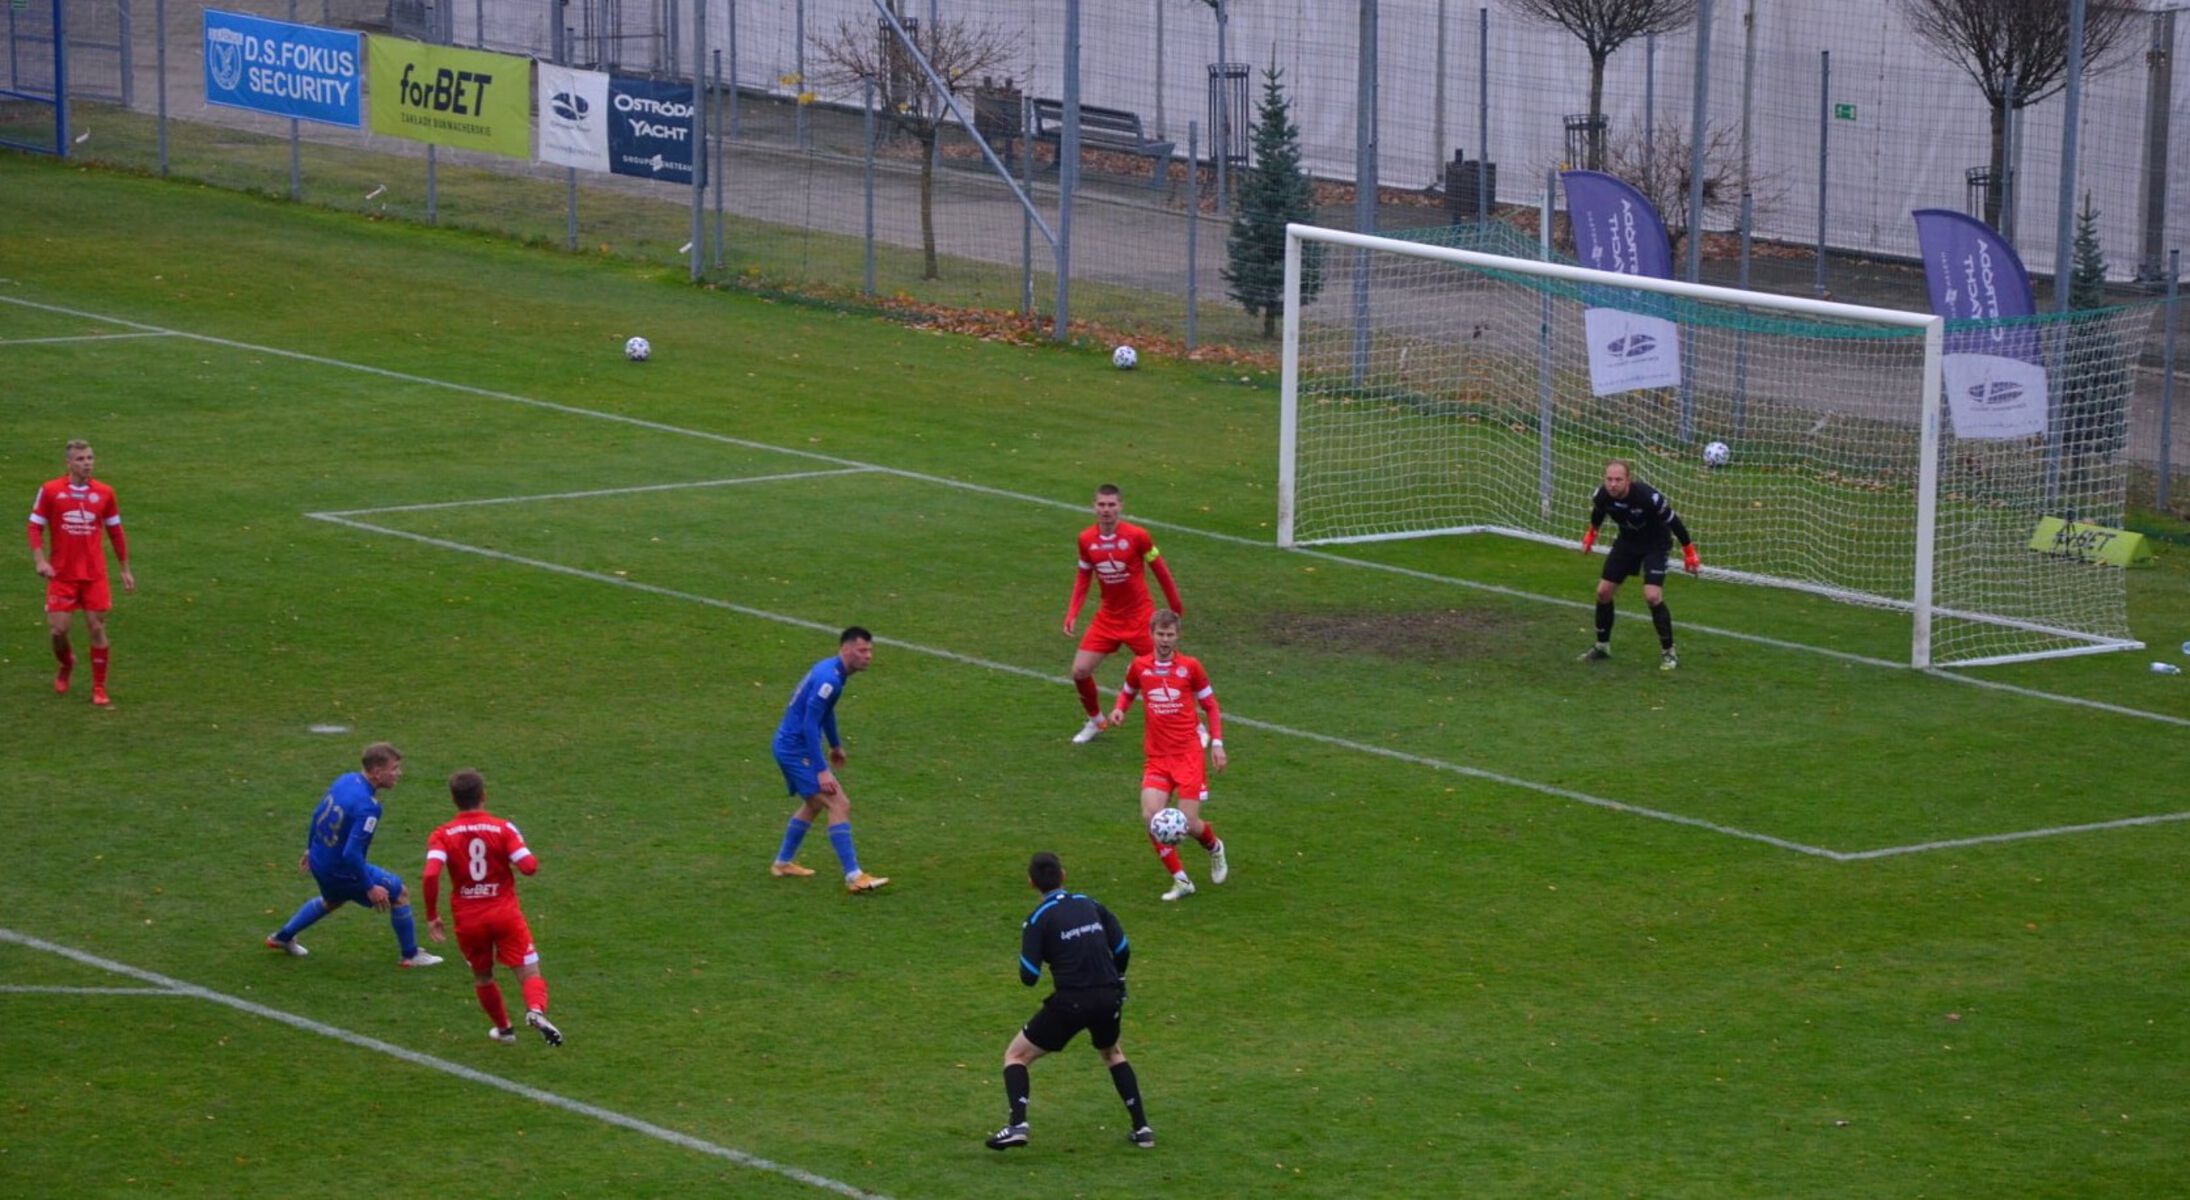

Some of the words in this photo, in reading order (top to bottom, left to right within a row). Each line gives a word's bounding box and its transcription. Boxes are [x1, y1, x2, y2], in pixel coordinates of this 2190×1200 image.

[244, 35, 355, 77] D.S.FOKUS
[248, 66, 350, 107] SECURITY
[400, 63, 492, 117] forBET
[613, 94, 694, 118] OSTRÓDA
[628, 118, 688, 141] YACHT
[316, 794, 344, 848] 23
[468, 837, 487, 881] 8
